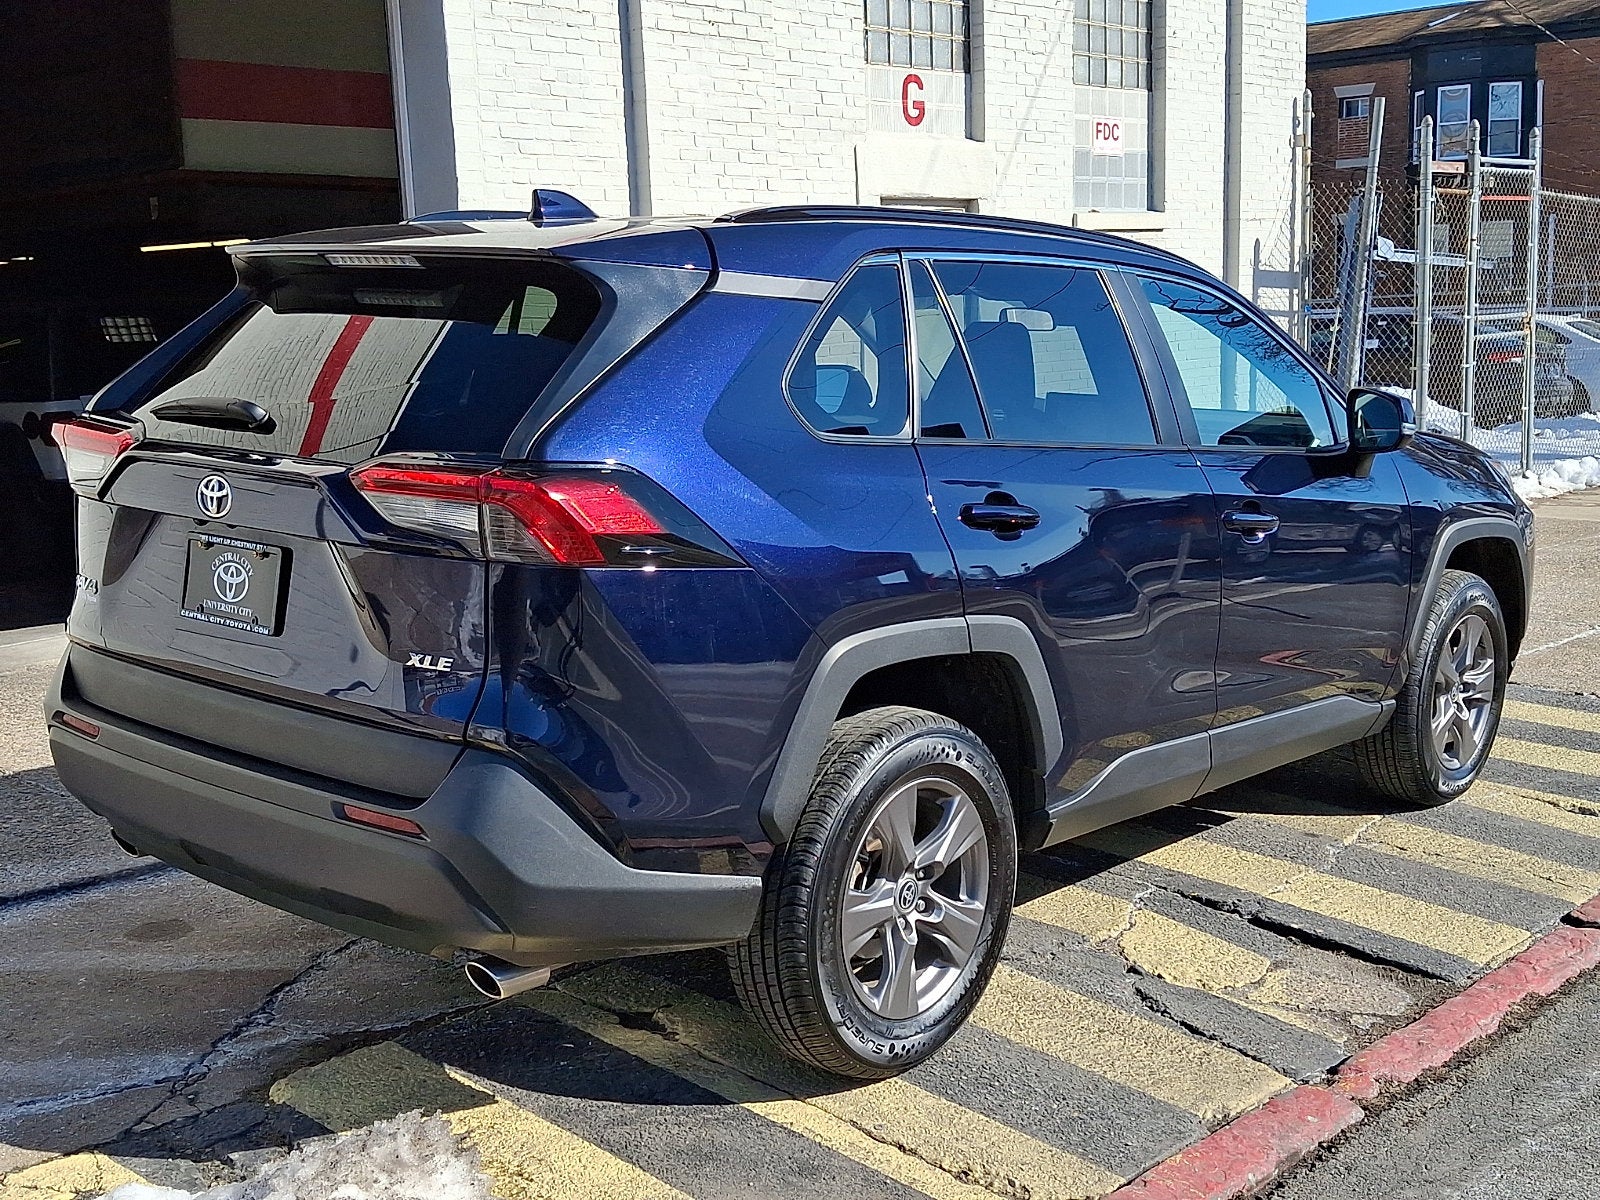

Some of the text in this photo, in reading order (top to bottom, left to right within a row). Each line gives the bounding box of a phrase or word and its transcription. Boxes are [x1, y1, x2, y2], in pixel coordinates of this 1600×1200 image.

[902, 74, 925, 126] G
[1096, 122, 1119, 141] FDC
[209, 536, 223, 544] LIGHT
[231, 540, 256, 549] CHESTNUT
[211, 552, 254, 577] CENTRAL CITY
[203, 599, 254, 618] UNIVERSITY CITY
[181, 609, 209, 621] CENTRAL
[209, 616, 225, 625] CITY
[225, 620, 251, 631] TOYOTA
[405, 652, 454, 671] XLE
